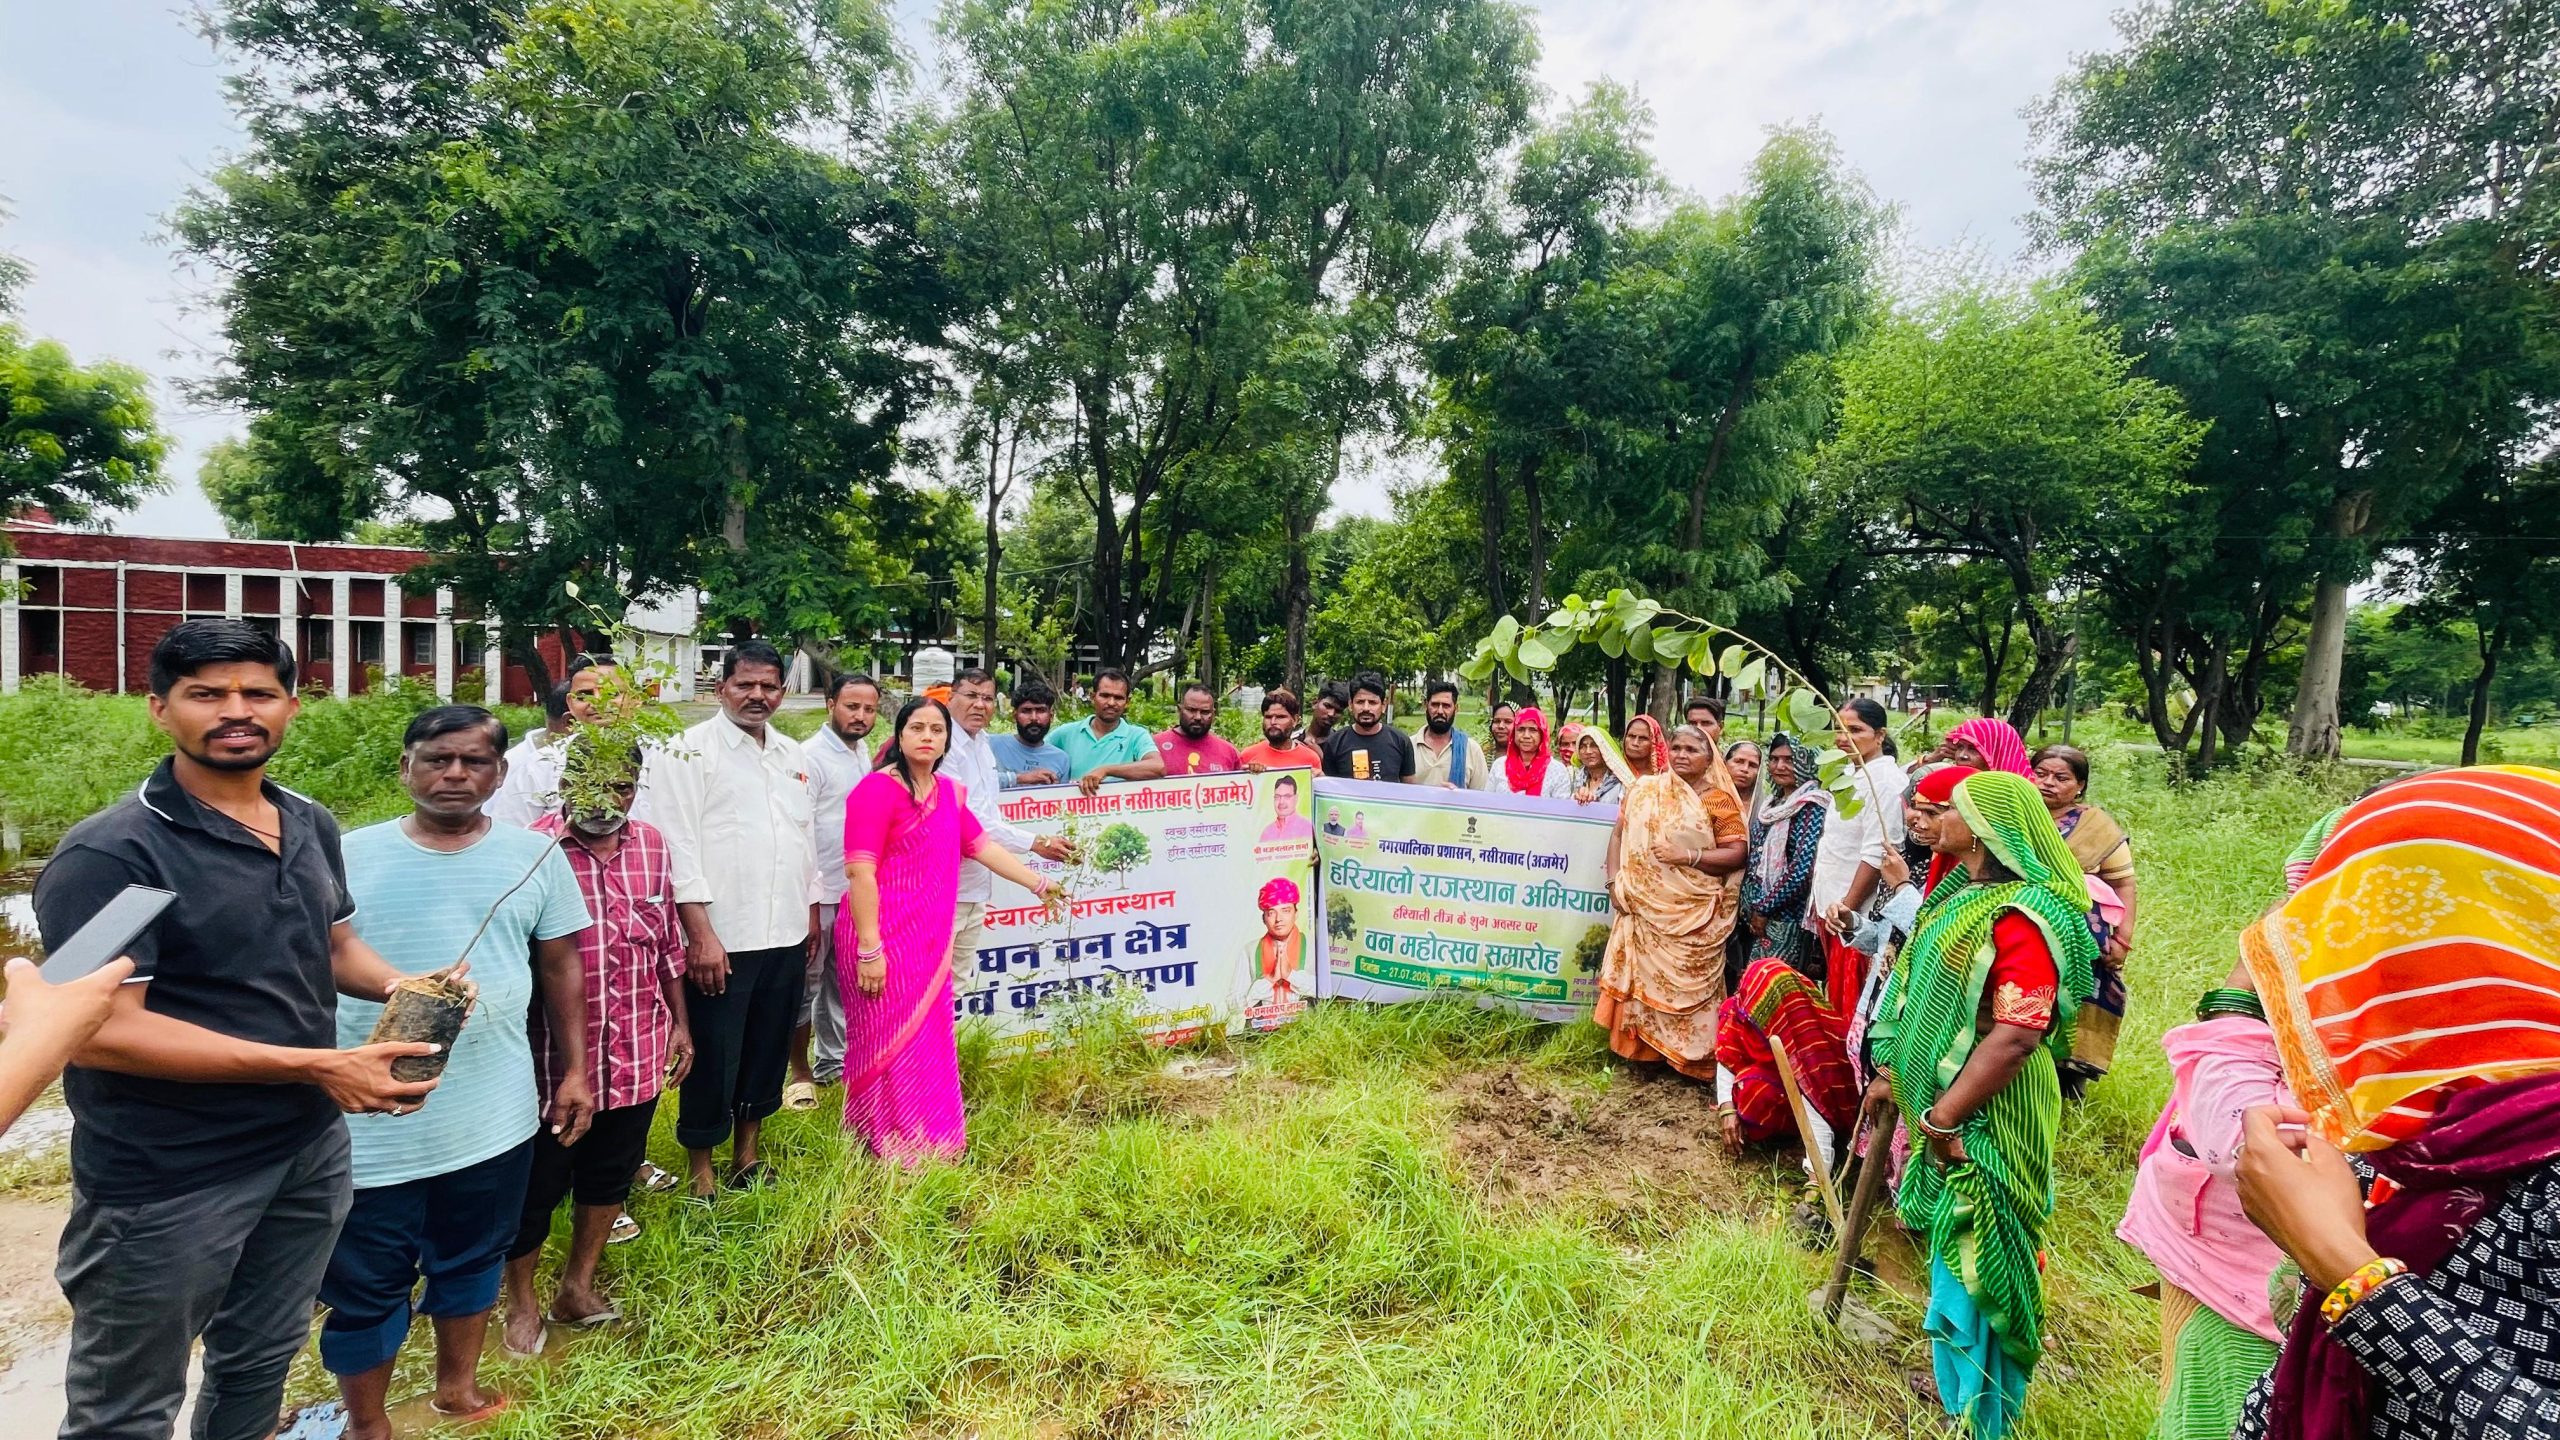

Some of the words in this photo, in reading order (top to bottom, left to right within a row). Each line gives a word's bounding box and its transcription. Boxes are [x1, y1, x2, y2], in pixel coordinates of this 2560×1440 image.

[1125, 787, 1191, 811] नसीराबाद
[1195, 780, 1253, 809] (अजमेर)
[1379, 839, 1434, 857] नगरपालिका
[1436, 845, 1475, 863] प्रशासन,
[1479, 847, 1525, 866] नसीराबाद
[1527, 851, 1569, 873] (अजमेर)
[1330, 858, 1415, 895] हरियालो
[1419, 874, 1517, 903] राजस्थान
[1522, 879, 1610, 914] अभियान
[1071, 890, 1176, 919] राजस्थान
[1393, 905, 1430, 921] हरियाली
[1434, 909, 1453, 924] तीज
[1457, 912, 1467, 925] के
[1470, 916, 1488, 931] शुभ
[1492, 918, 1521, 931] अवसर
[1525, 922, 1538, 932] पर
[1053, 933, 1116, 963] वन
[1125, 921, 1191, 955] क्षेत्र
[1365, 930, 1396, 954] वन
[1400, 931, 1480, 964] महोत्सव
[1485, 942, 1561, 974] समारोह
